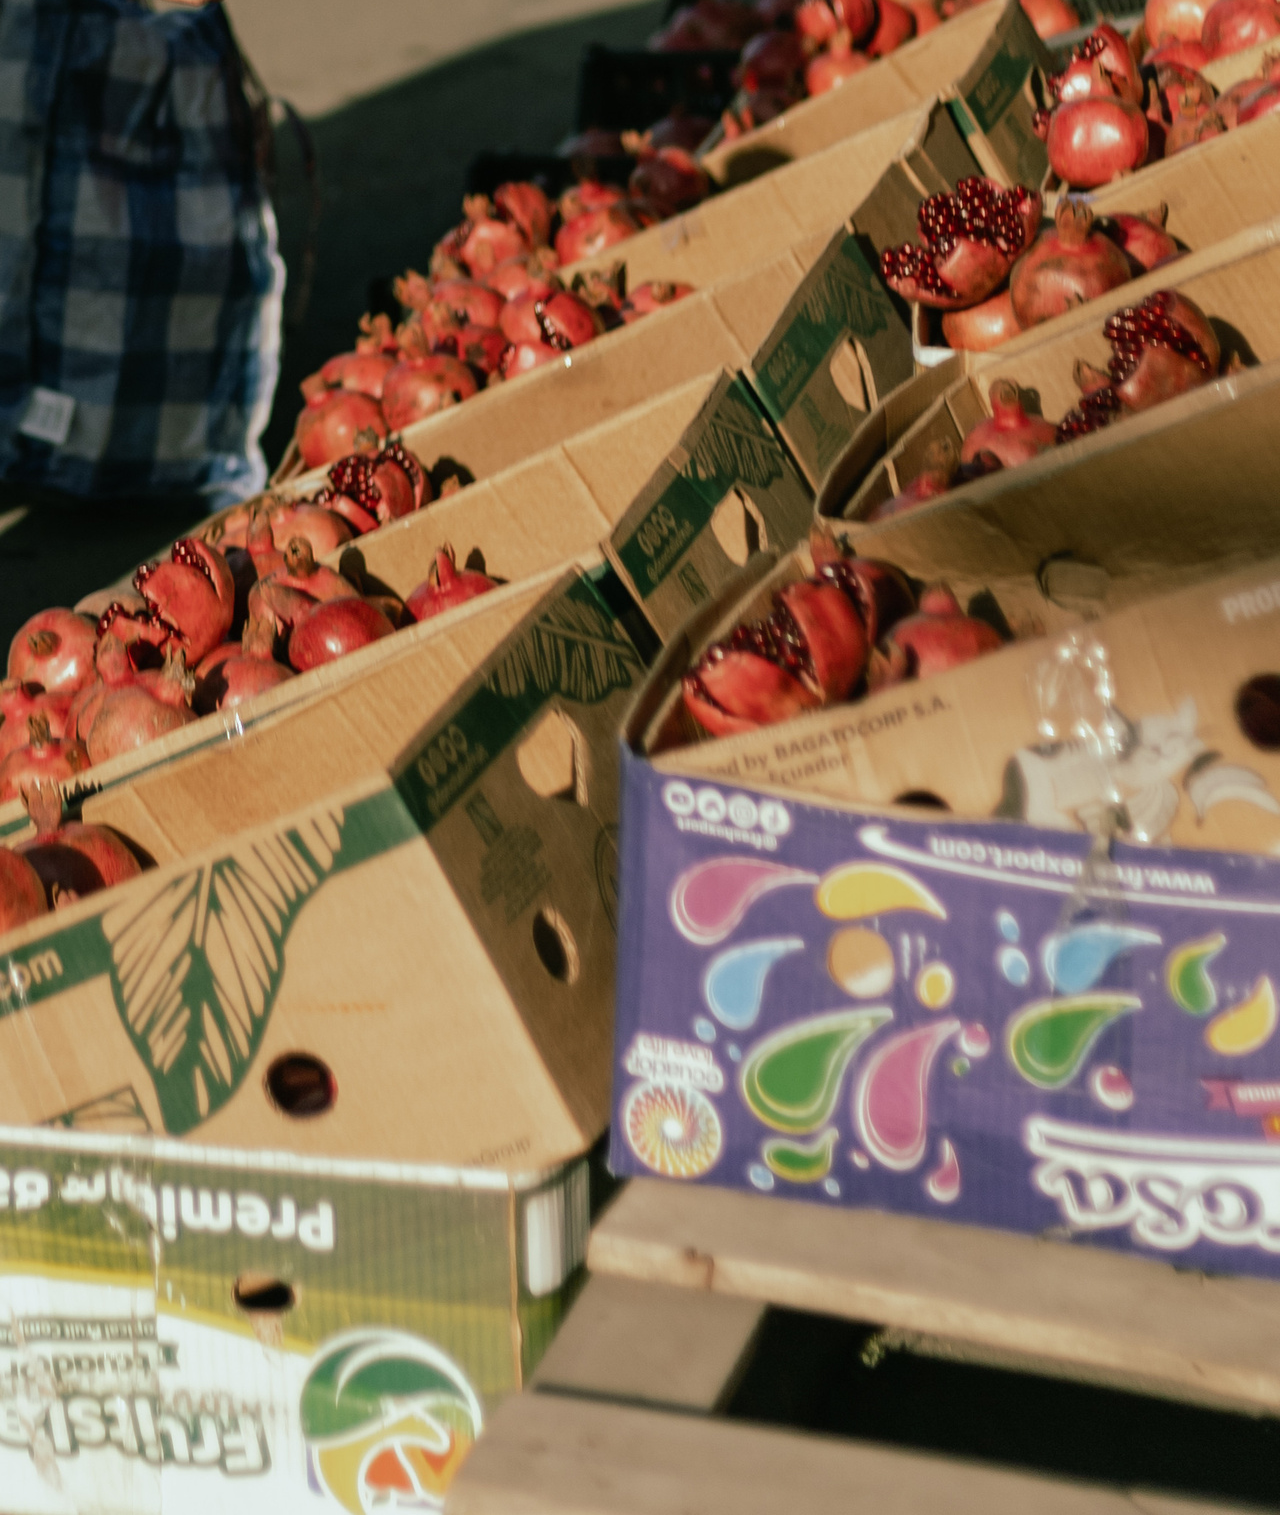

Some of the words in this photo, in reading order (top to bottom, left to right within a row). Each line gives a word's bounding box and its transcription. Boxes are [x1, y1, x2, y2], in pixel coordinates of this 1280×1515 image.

[742, 750, 769, 773] by
[911, 693, 953, 721] S.A.
[1040, 1164, 1280, 1250] osa
